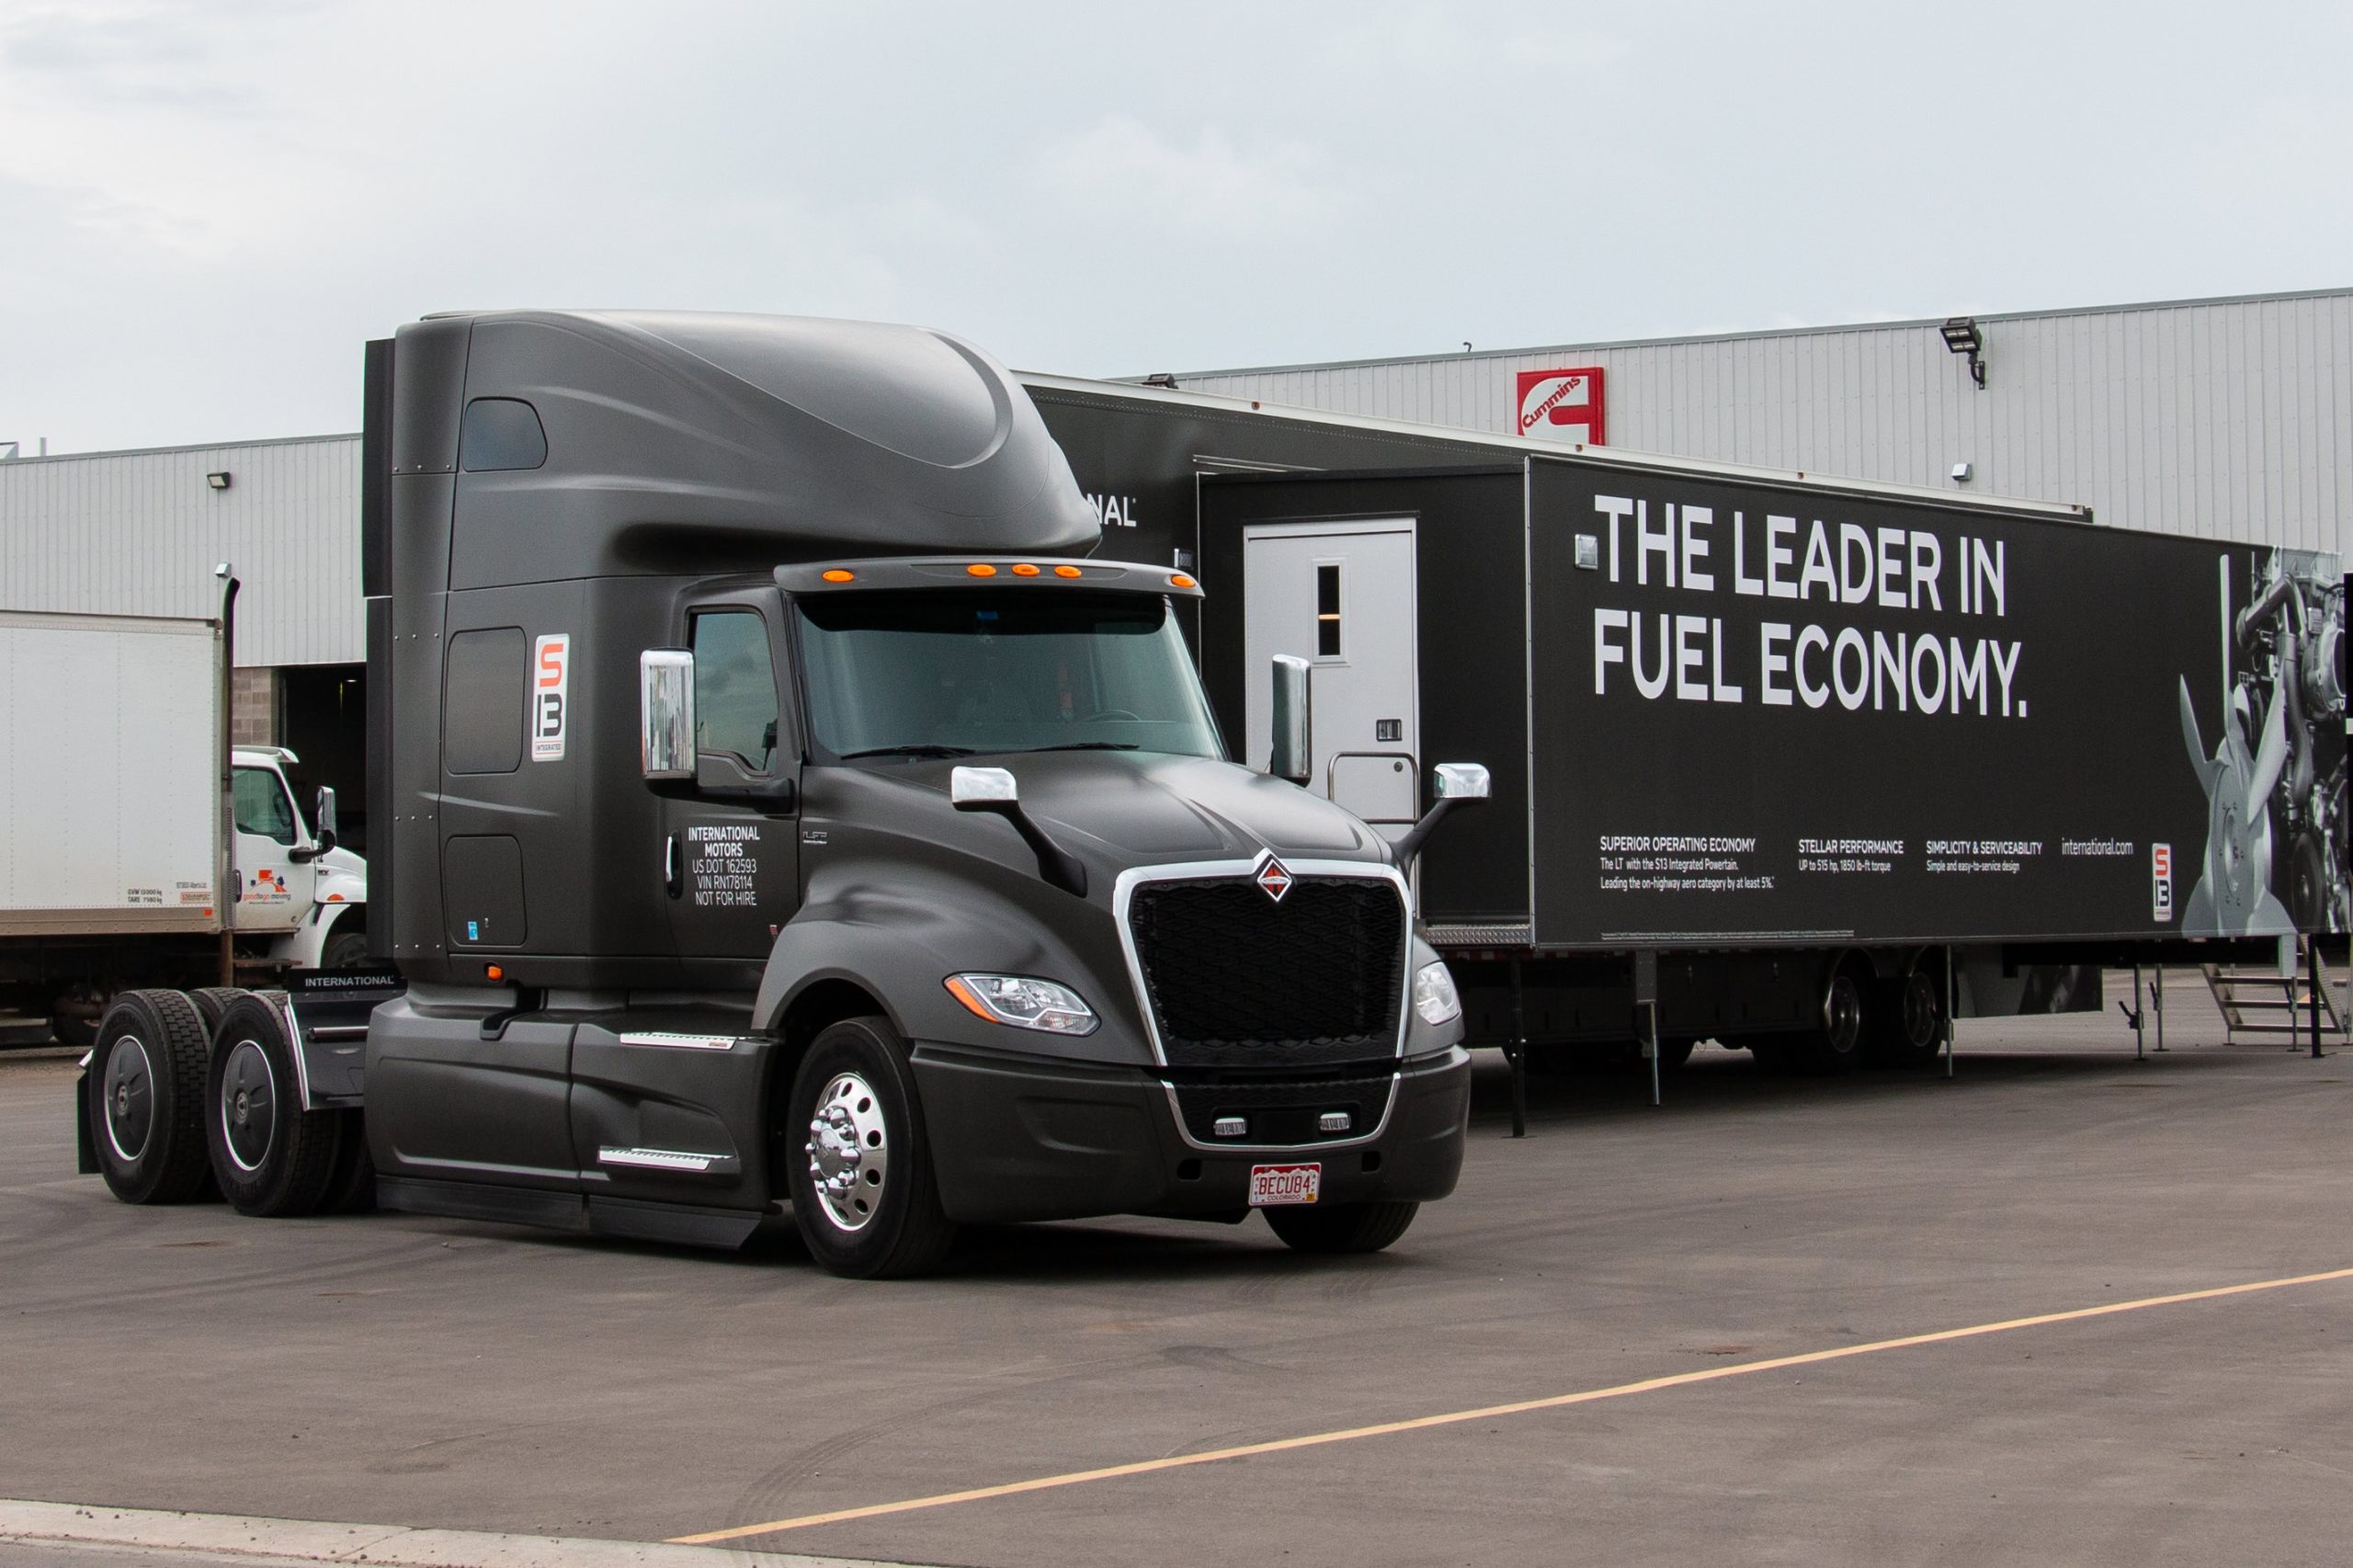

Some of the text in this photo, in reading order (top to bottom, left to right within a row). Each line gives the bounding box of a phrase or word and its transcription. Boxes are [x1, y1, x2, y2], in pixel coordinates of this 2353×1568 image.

[1522, 377, 1581, 427] Cummins
[1594, 494, 2005, 617] THE LEADER IN
[1595, 608, 2028, 718] FUEL ECONOMY.
[688, 826, 761, 842] INTERNATIONAL
[705, 843, 744, 858] MOTORS
[1600, 836, 1756, 853] SUPERIOR OPERATING ECONOMY
[1799, 839, 1904, 855] STELLAR PERFORMANCE
[1927, 841, 2042, 855] SIMPLICITY & SERVICEABILITY
[2063, 837, 2133, 856] international.com
[693, 858, 757, 874] US DOT 162593
[1600, 858, 1614, 870] The
[1615, 858, 1624, 870] LT
[1626, 858, 1642, 870] with
[1643, 858, 1654, 870] the
[1655, 858, 1668, 870] S13
[1669, 858, 1704, 873] Integrated
[1809, 861, 1817, 871] to
[1871, 860, 1892, 874] torque
[1927, 860, 1946, 874] Simple
[1947, 860, 1958, 871] and
[2002, 860, 2020, 874] design
[698, 875, 753, 891] VIN RN178114
[1601, 877, 1628, 892] Leading
[1629, 877, 1642, 890] the
[1642, 877, 1681, 892] on-highway
[1682, 880, 1697, 890] aero
[1698, 878, 1727, 892] category
[1727, 877, 1736, 892] by
[1736, 878, 1744, 889] at
[1745, 877, 1761, 889] least
[696, 892, 757, 906] NOT FOR HIRE
[305, 975, 394, 987] INTERNATIONAL
[1258, 1176, 1311, 1195] BECU84
